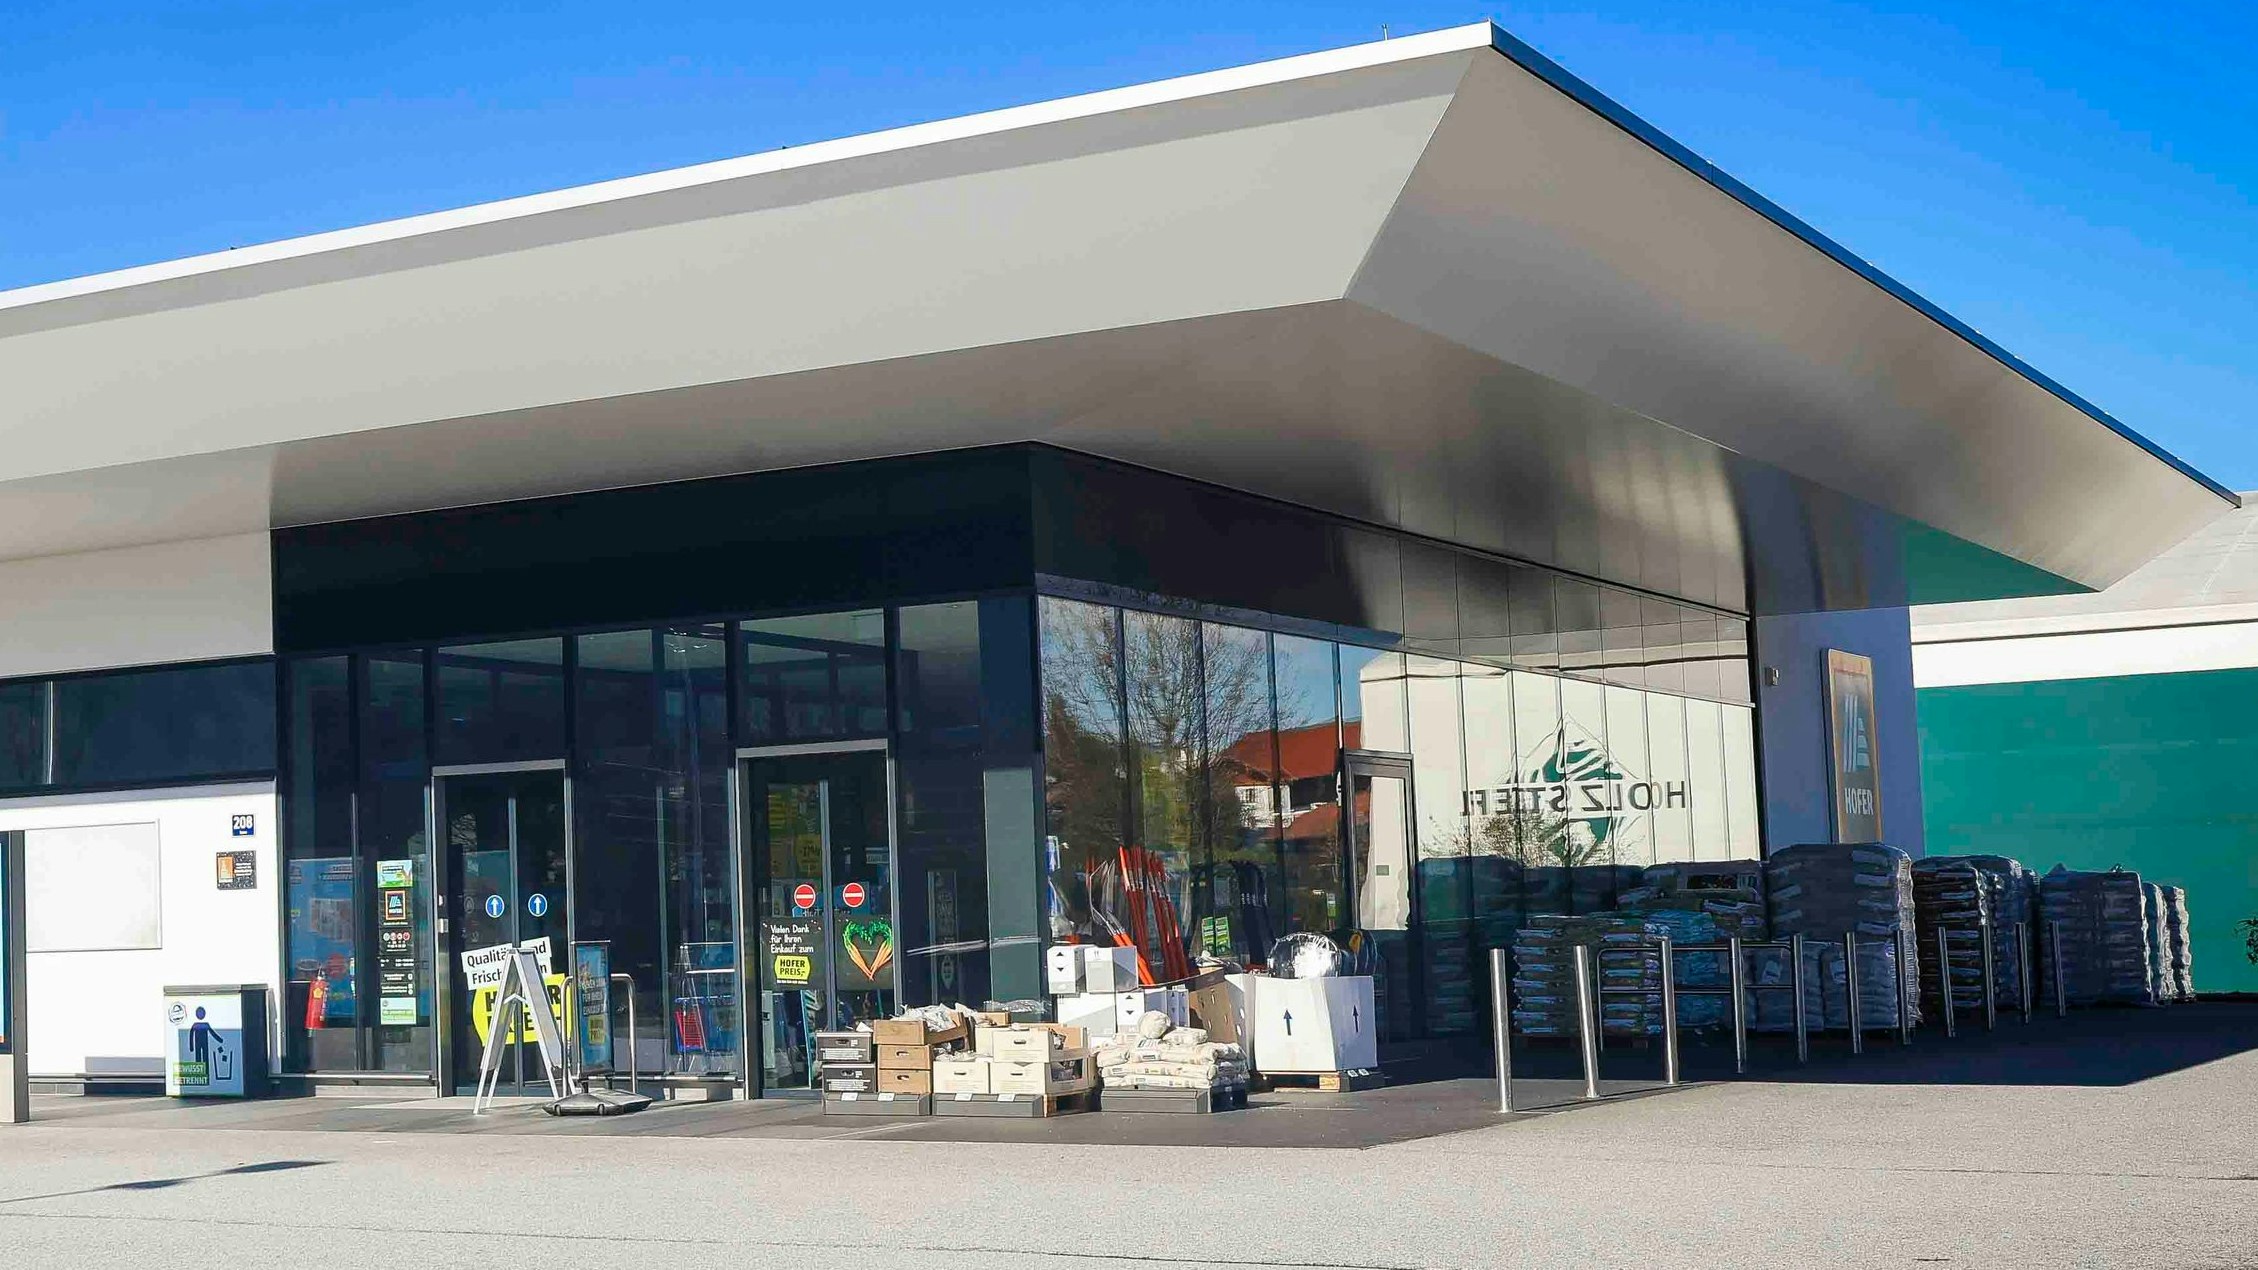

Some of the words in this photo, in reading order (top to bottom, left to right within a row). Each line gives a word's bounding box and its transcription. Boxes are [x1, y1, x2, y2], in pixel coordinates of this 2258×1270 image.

[1844, 787, 1874, 816] HOFER
[233, 815, 253, 830] 208
[770, 924, 790, 934] Vielen
[792, 923, 810, 934] Dank
[770, 934, 782, 944] für
[784, 934, 803, 944] Ihren
[770, 943, 797, 954] Einkauf
[798, 945, 814, 953] zum
[467, 946, 509, 968] Qualitä
[779, 958, 806, 968] HOFER
[472, 967, 503, 985] Frisch
